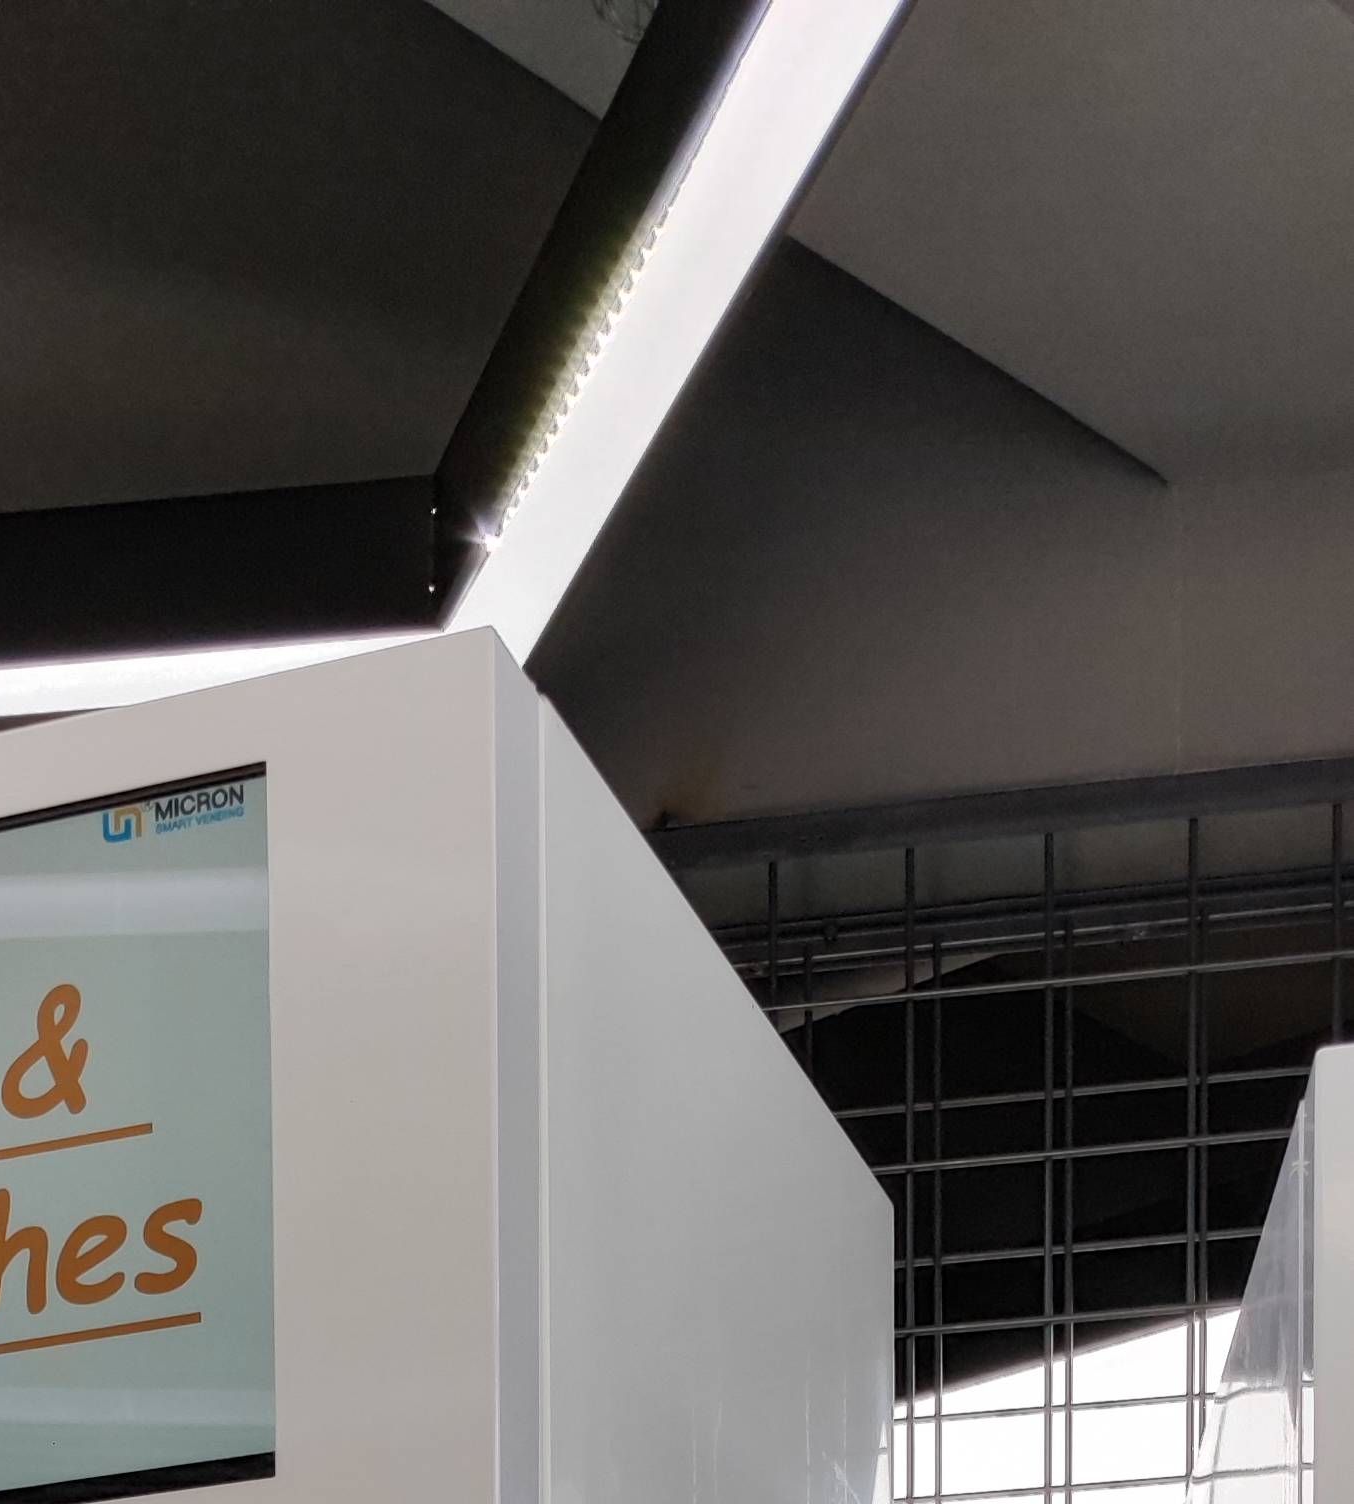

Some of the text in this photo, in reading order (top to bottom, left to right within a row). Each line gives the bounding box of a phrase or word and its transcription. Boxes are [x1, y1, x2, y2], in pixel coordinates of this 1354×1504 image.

[155, 785, 244, 821] MICRON
[155, 818, 192, 834] SMART
[2, 984, 88, 1117] &
